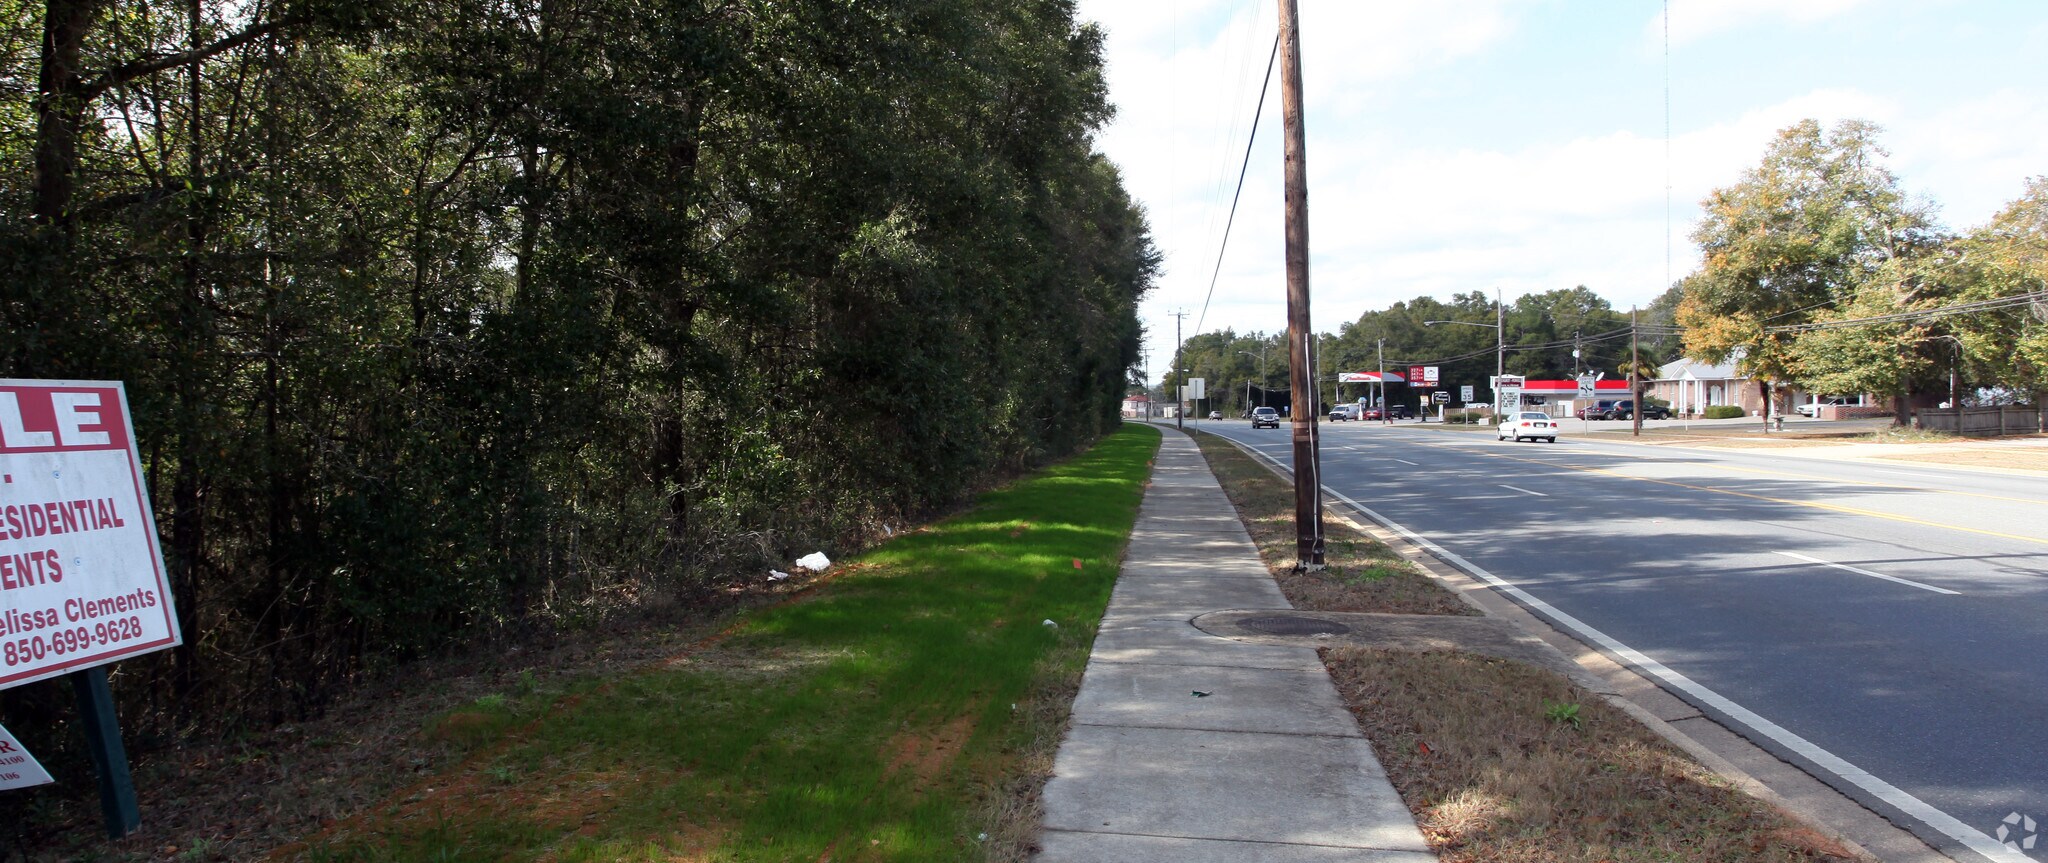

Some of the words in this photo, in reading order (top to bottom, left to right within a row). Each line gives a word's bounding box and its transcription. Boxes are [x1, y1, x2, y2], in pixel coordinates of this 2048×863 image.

[0, 391, 111, 448] LE
[0, 549, 63, 591] ENTS
[64, 588, 157, 622] Clements
[4, 616, 143, 667] 850-699-9628
